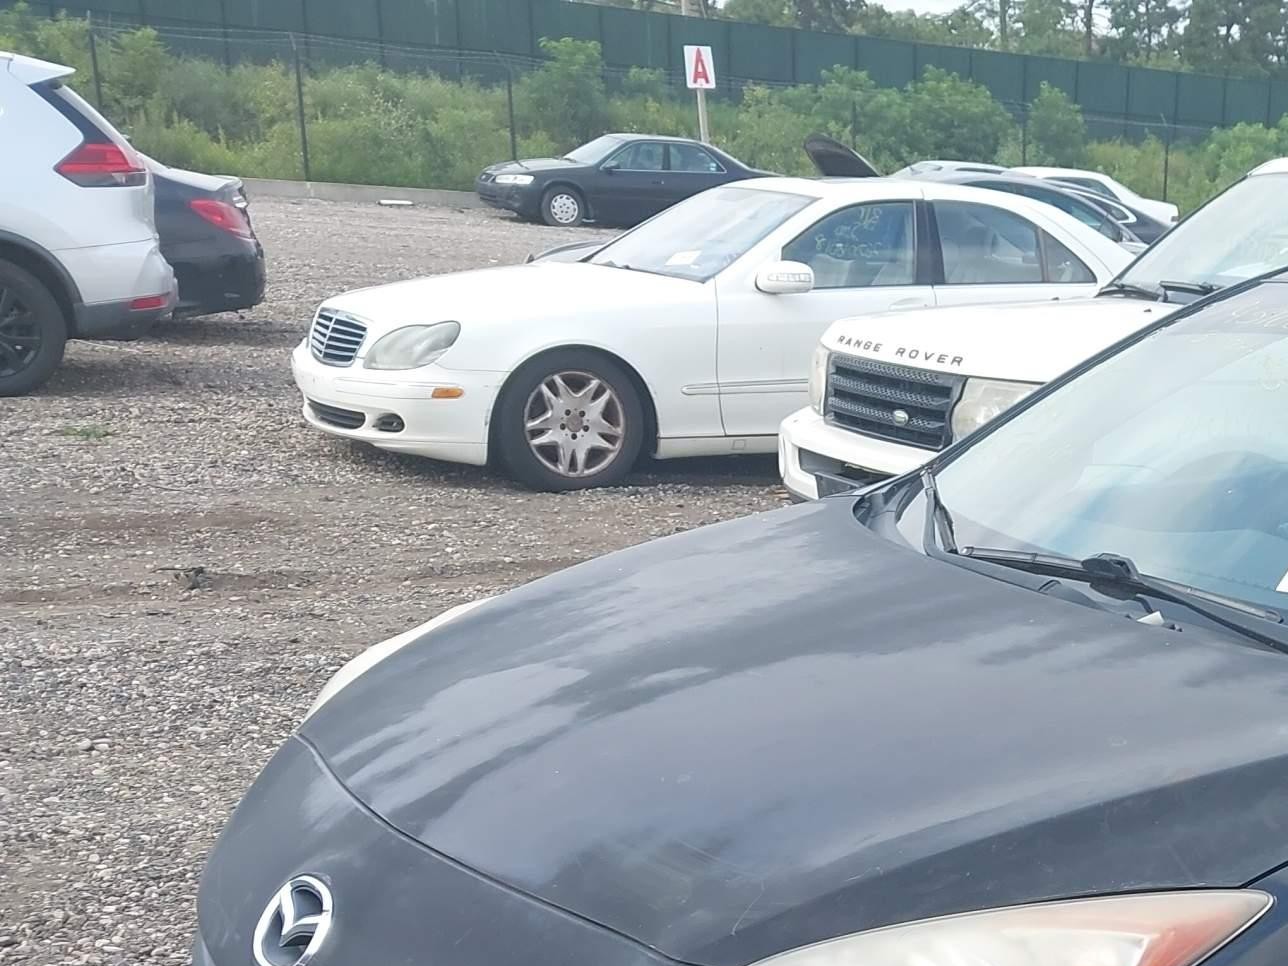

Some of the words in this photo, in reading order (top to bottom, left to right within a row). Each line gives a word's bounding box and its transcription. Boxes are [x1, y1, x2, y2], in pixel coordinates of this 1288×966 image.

[692, 48, 710, 84] A
[837, 335, 884, 352] RANGE
[895, 347, 963, 367] ROVER
